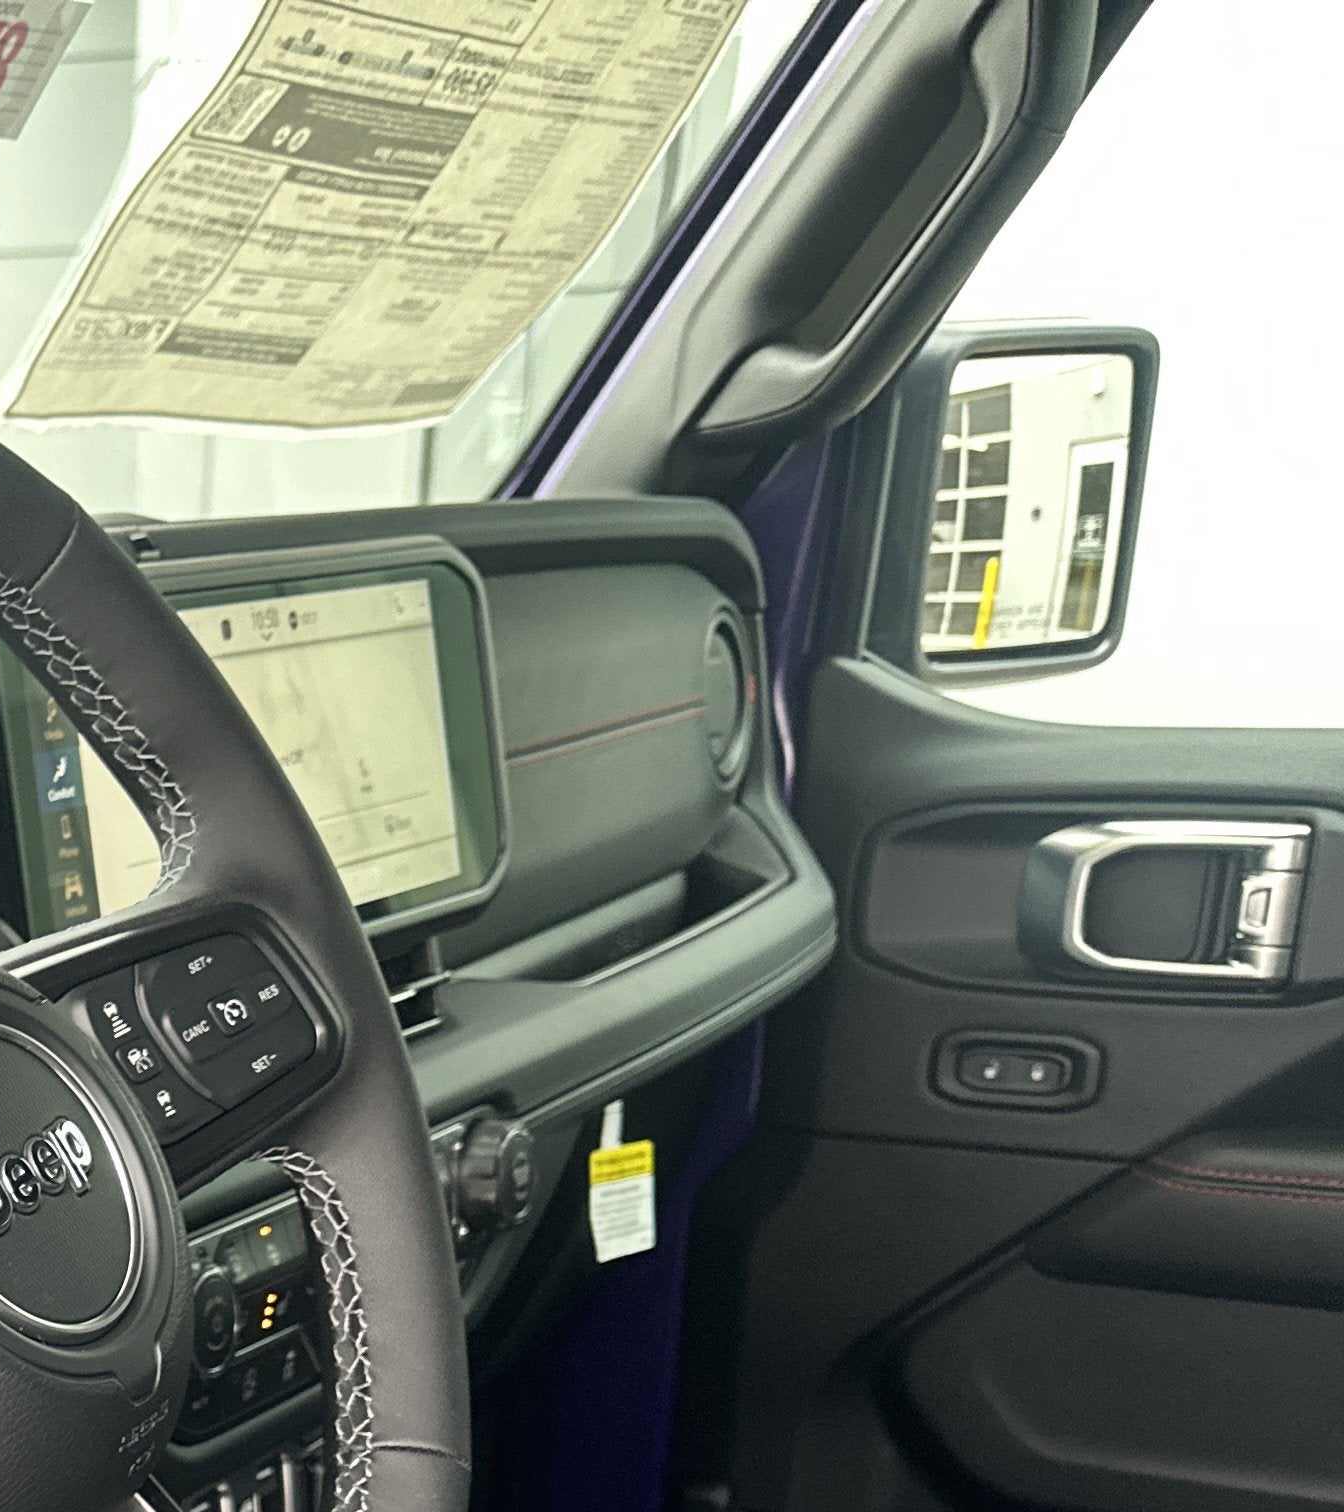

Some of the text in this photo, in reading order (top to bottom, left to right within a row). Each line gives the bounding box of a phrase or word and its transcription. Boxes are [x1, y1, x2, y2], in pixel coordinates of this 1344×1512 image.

[187, 956, 213, 974] SET+
[258, 983, 280, 1002] RES
[182, 1019, 210, 1042] CANC
